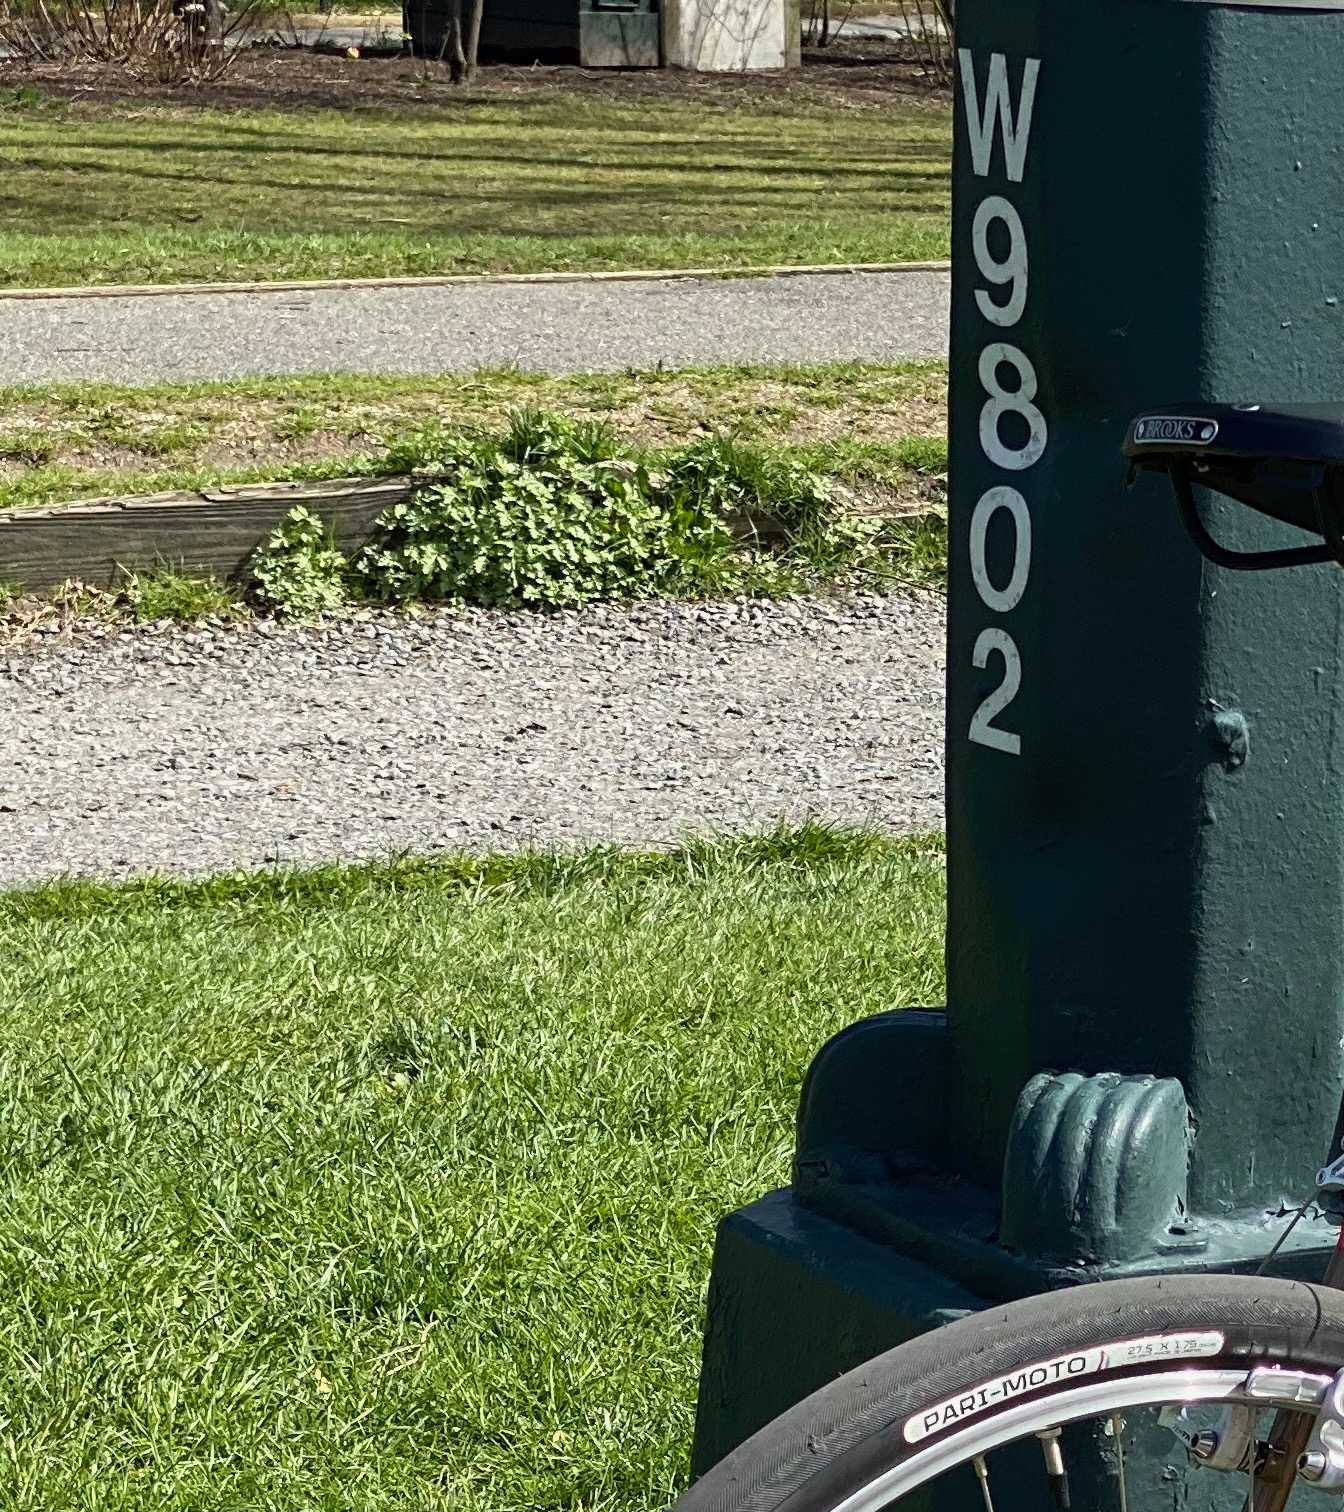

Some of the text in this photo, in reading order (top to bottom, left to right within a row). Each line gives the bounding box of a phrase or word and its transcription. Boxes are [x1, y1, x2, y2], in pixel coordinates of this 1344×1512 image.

[957, 48, 1048, 756] W9802
[1145, 420, 1196, 439] BROOKS
[923, 1357, 1087, 1433] PARI-MOTO
